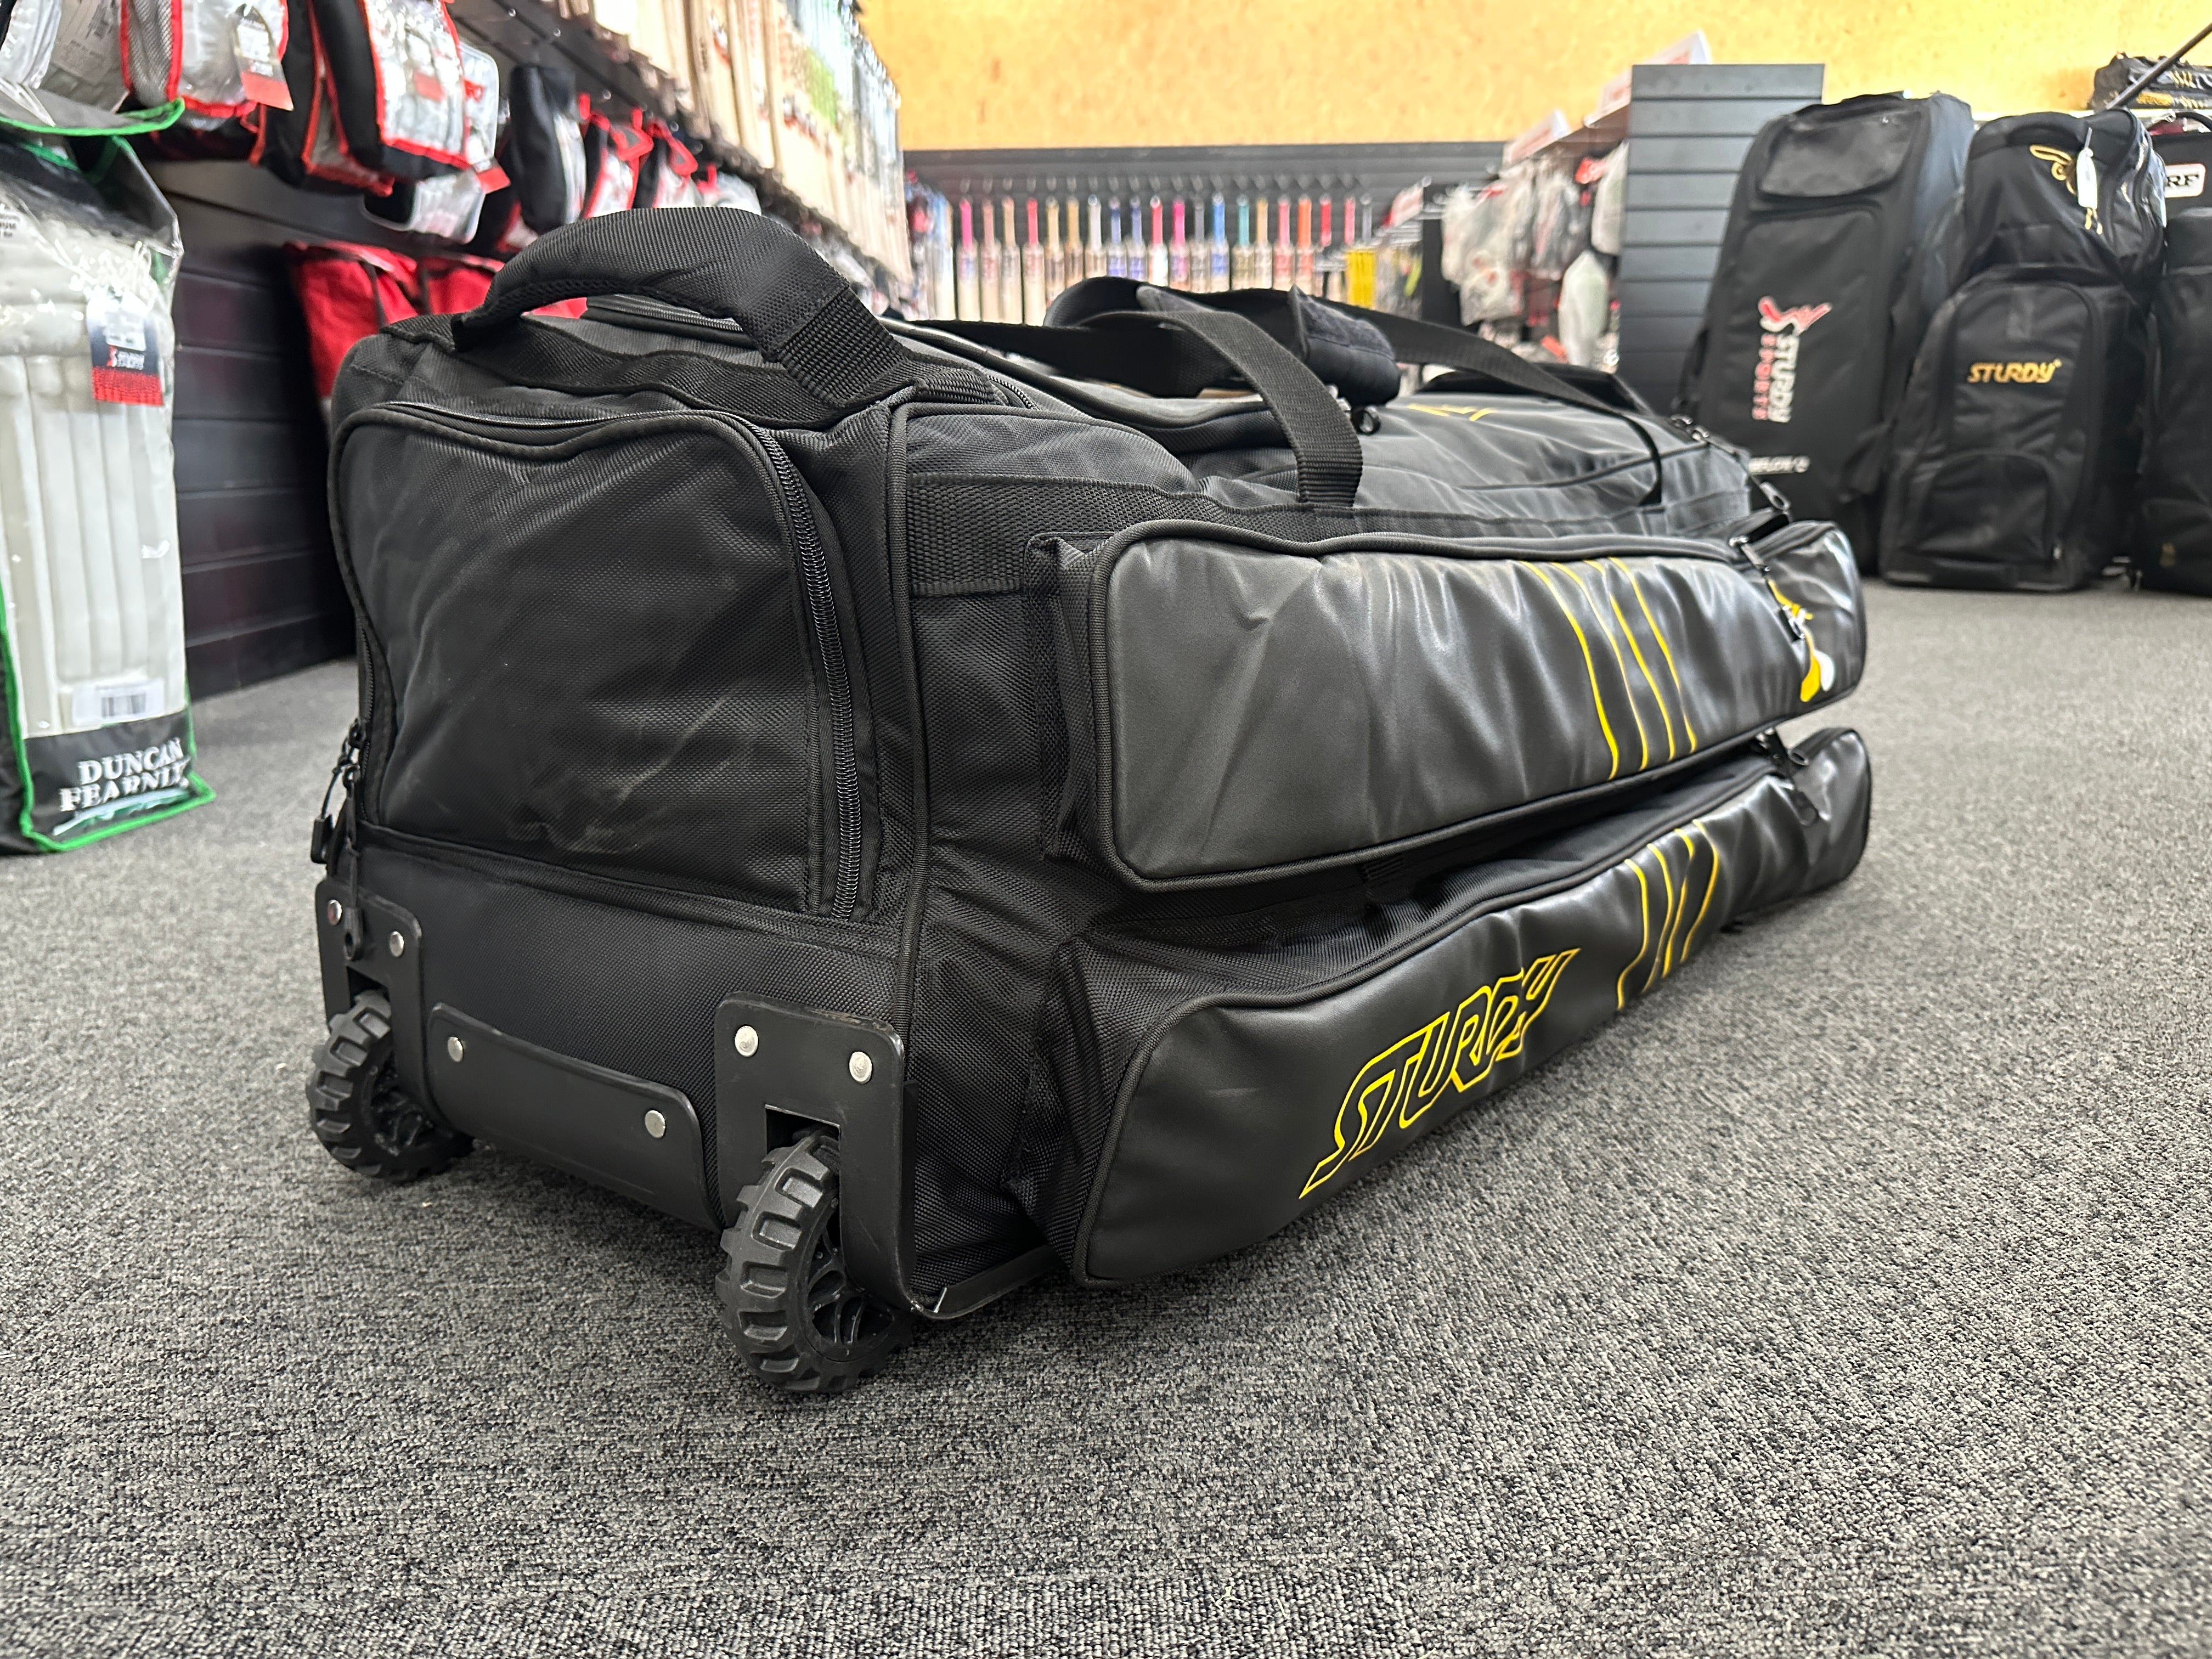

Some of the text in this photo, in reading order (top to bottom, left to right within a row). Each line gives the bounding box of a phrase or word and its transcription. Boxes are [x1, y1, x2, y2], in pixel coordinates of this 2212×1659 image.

[2164, 173, 2199, 188] RF
[1767, 332, 1800, 422] STURDY
[1967, 361, 2058, 383] STURDY
[78, 737, 184, 785] DUNCAN
[1299, 948, 1581, 1199] STURDY
